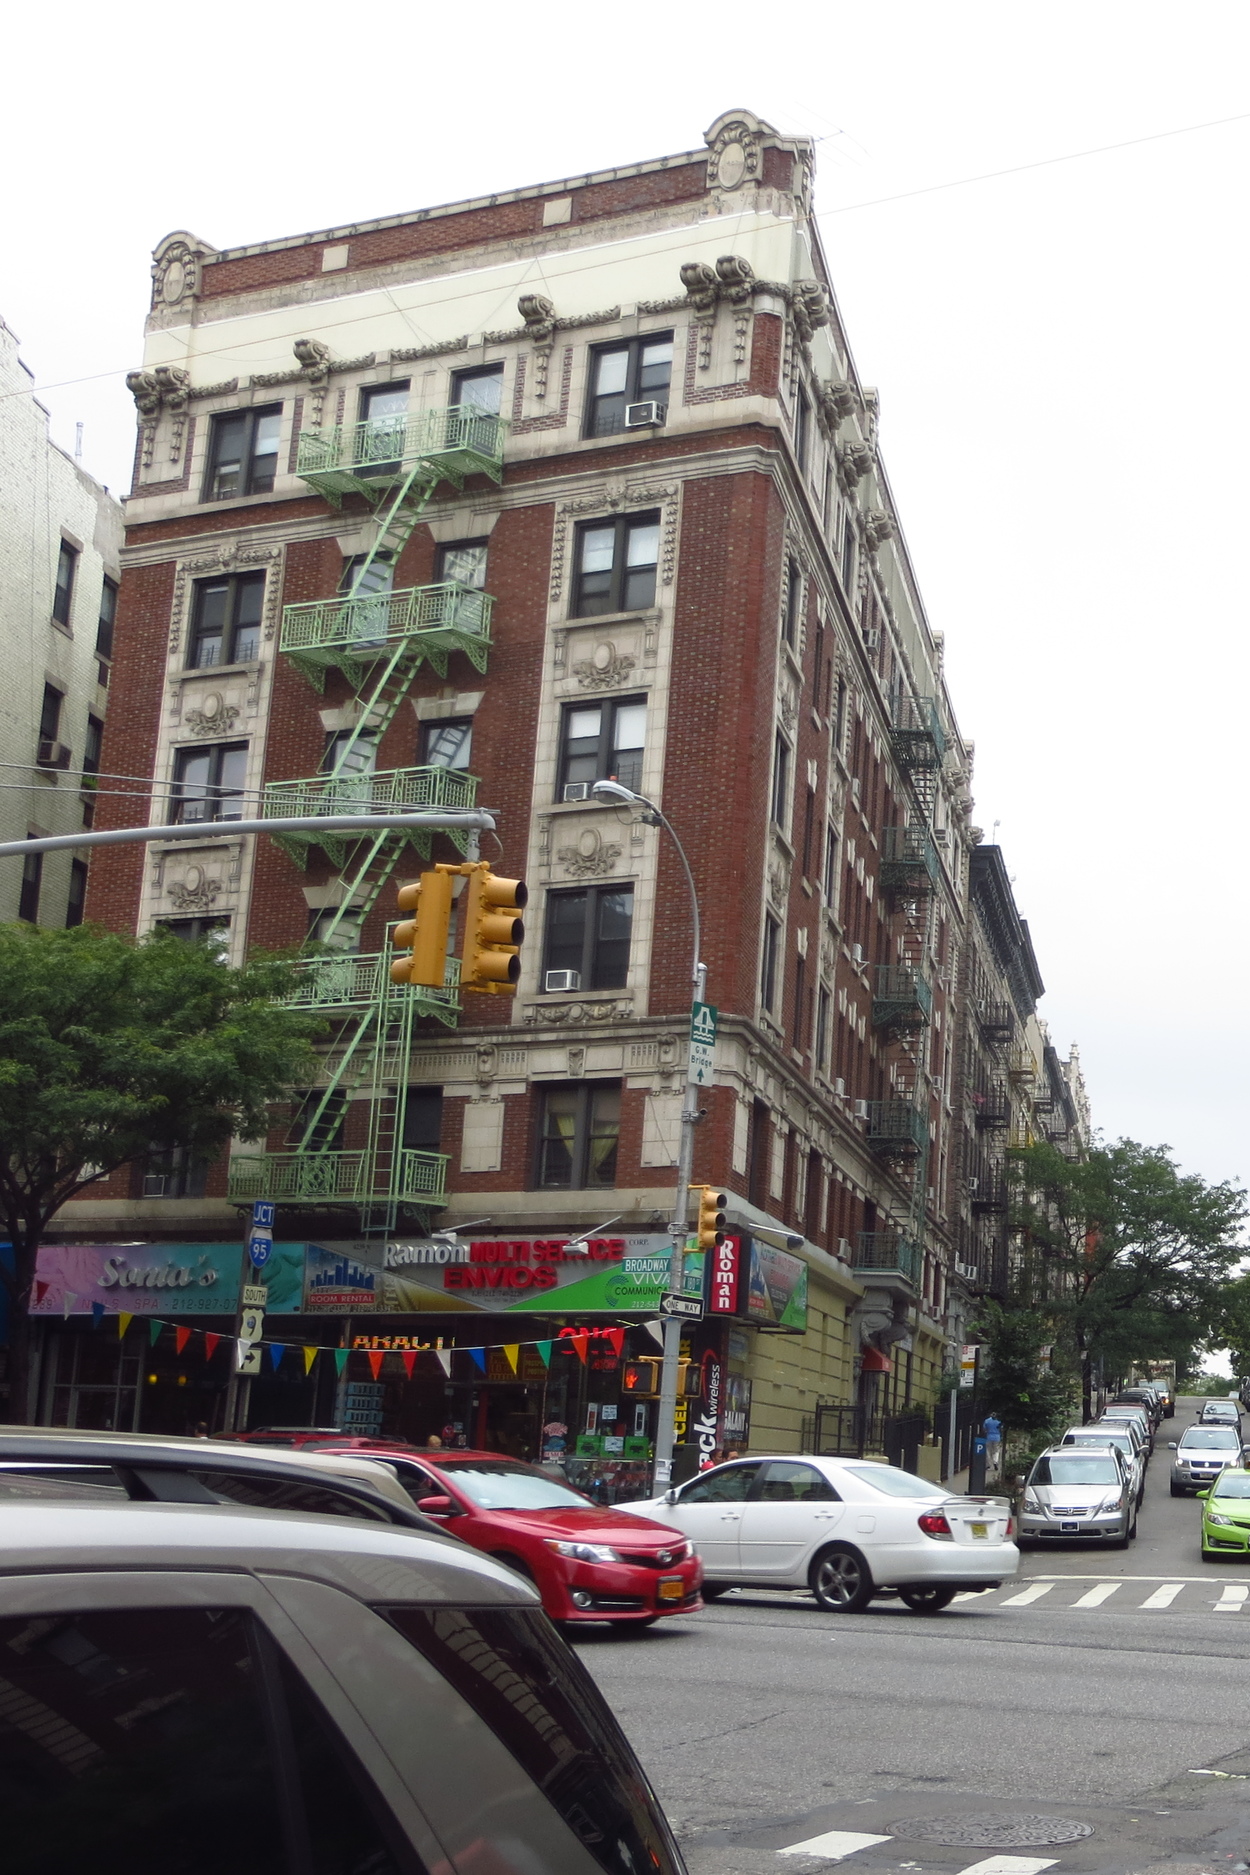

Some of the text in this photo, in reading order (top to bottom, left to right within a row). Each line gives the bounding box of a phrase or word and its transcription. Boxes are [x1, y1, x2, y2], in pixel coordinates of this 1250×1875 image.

[691, 1055, 712, 1067] Bridge
[254, 1206, 274, 1223] JCT
[253, 1245, 267, 1260] 95
[384, 1243, 468, 1267] Ramon
[470, 1241, 530, 1262] MULTI
[533, 1239, 625, 1261] SEICE
[97, 1255, 217, 1287] Sonia's
[625, 1259, 670, 1272] BROADWAY
[444, 1266, 558, 1289] ENVIOS
[716, 1239, 735, 1309] Roman
[245, 1288, 266, 1301] SOUTH
[341, 1294, 373, 1302] RENTAL
[134, 1300, 159, 1310] SPA
[666, 1300, 699, 1313] ONE WAY
[248, 1316, 256, 1336] 9
[710, 1363, 721, 1415] wireless
